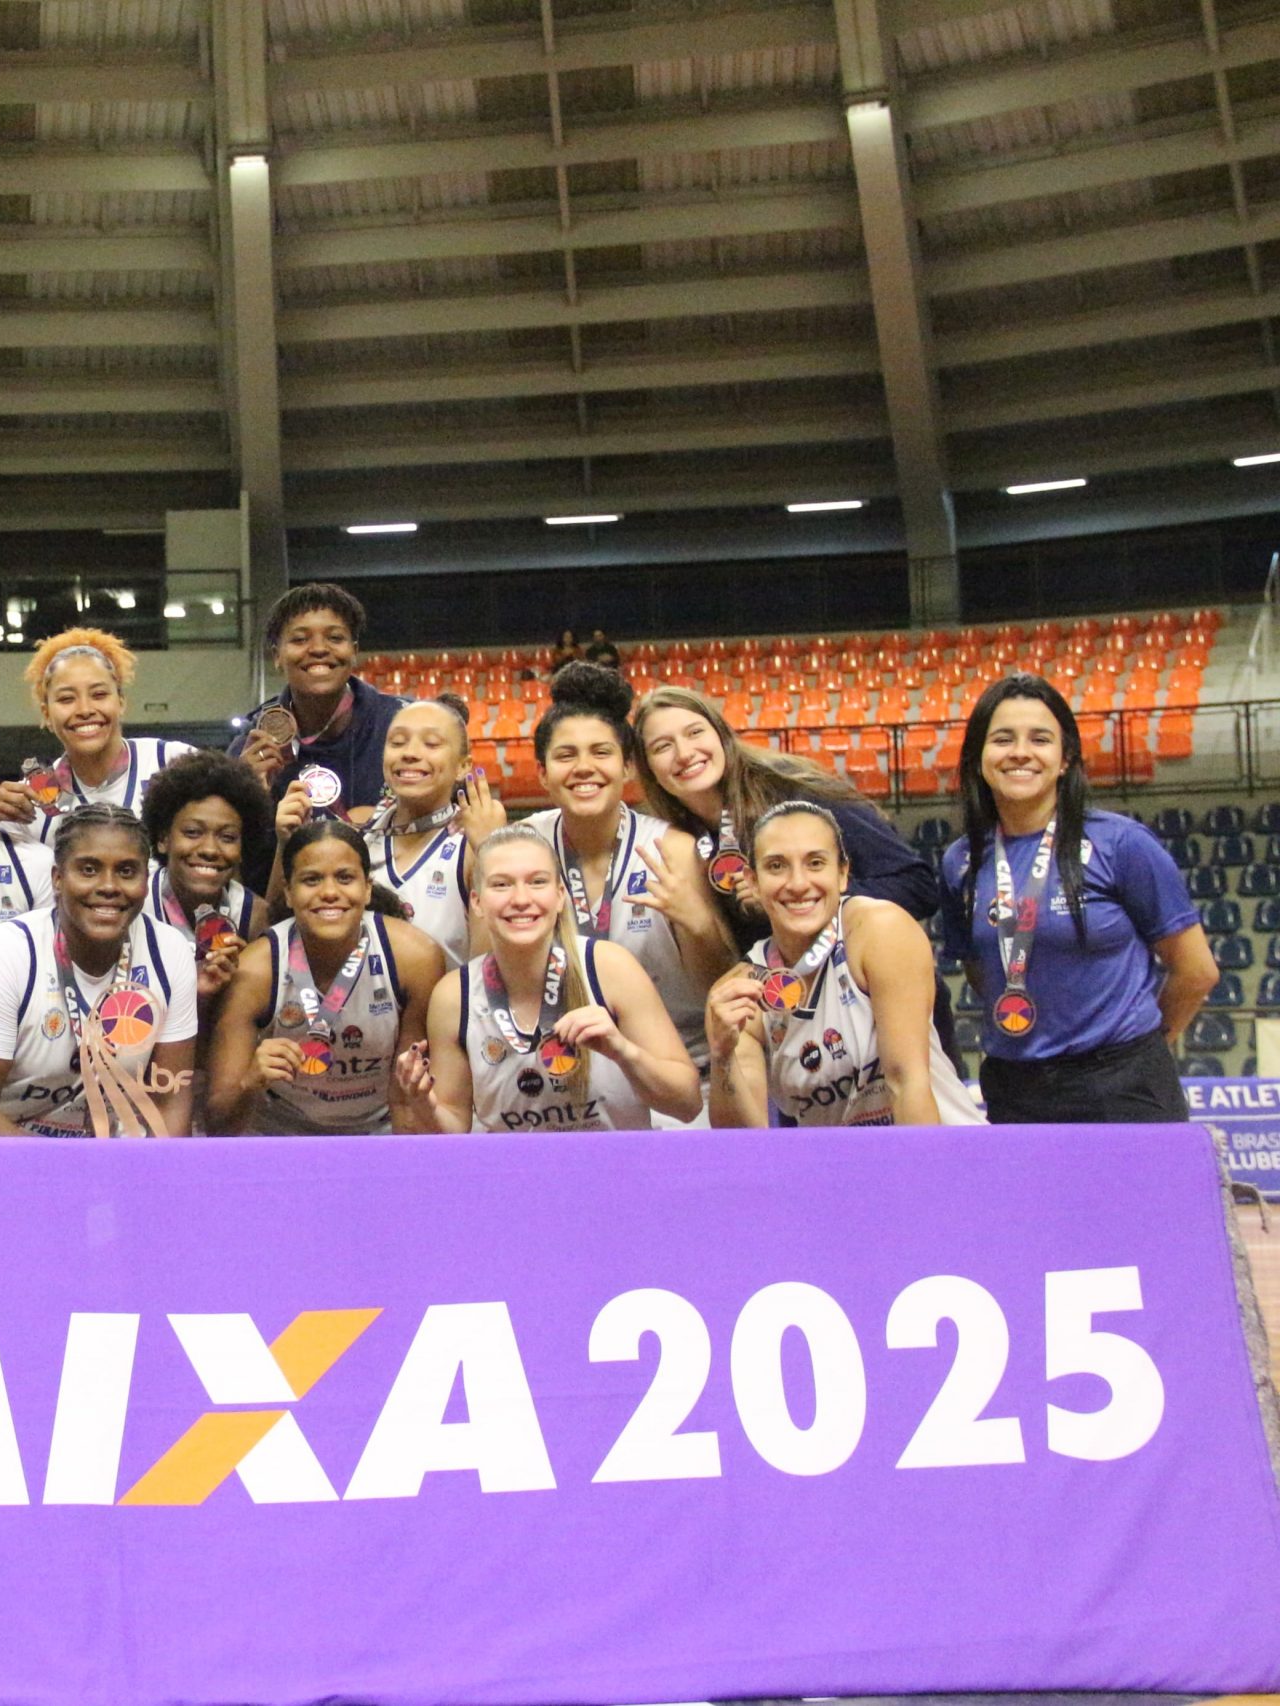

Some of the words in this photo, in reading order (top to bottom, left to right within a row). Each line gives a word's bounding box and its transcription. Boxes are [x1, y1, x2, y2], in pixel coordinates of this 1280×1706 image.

[1032, 821, 1057, 879] CAIXA
[568, 868, 590, 925] CAIXA
[996, 859, 1014, 920] CAIXA
[341, 937, 369, 978] CAIXA
[545, 946, 567, 1006] CAIXA
[494, 1008, 532, 1054] CAIXA
[588, 1265, 1166, 1484] 2025
